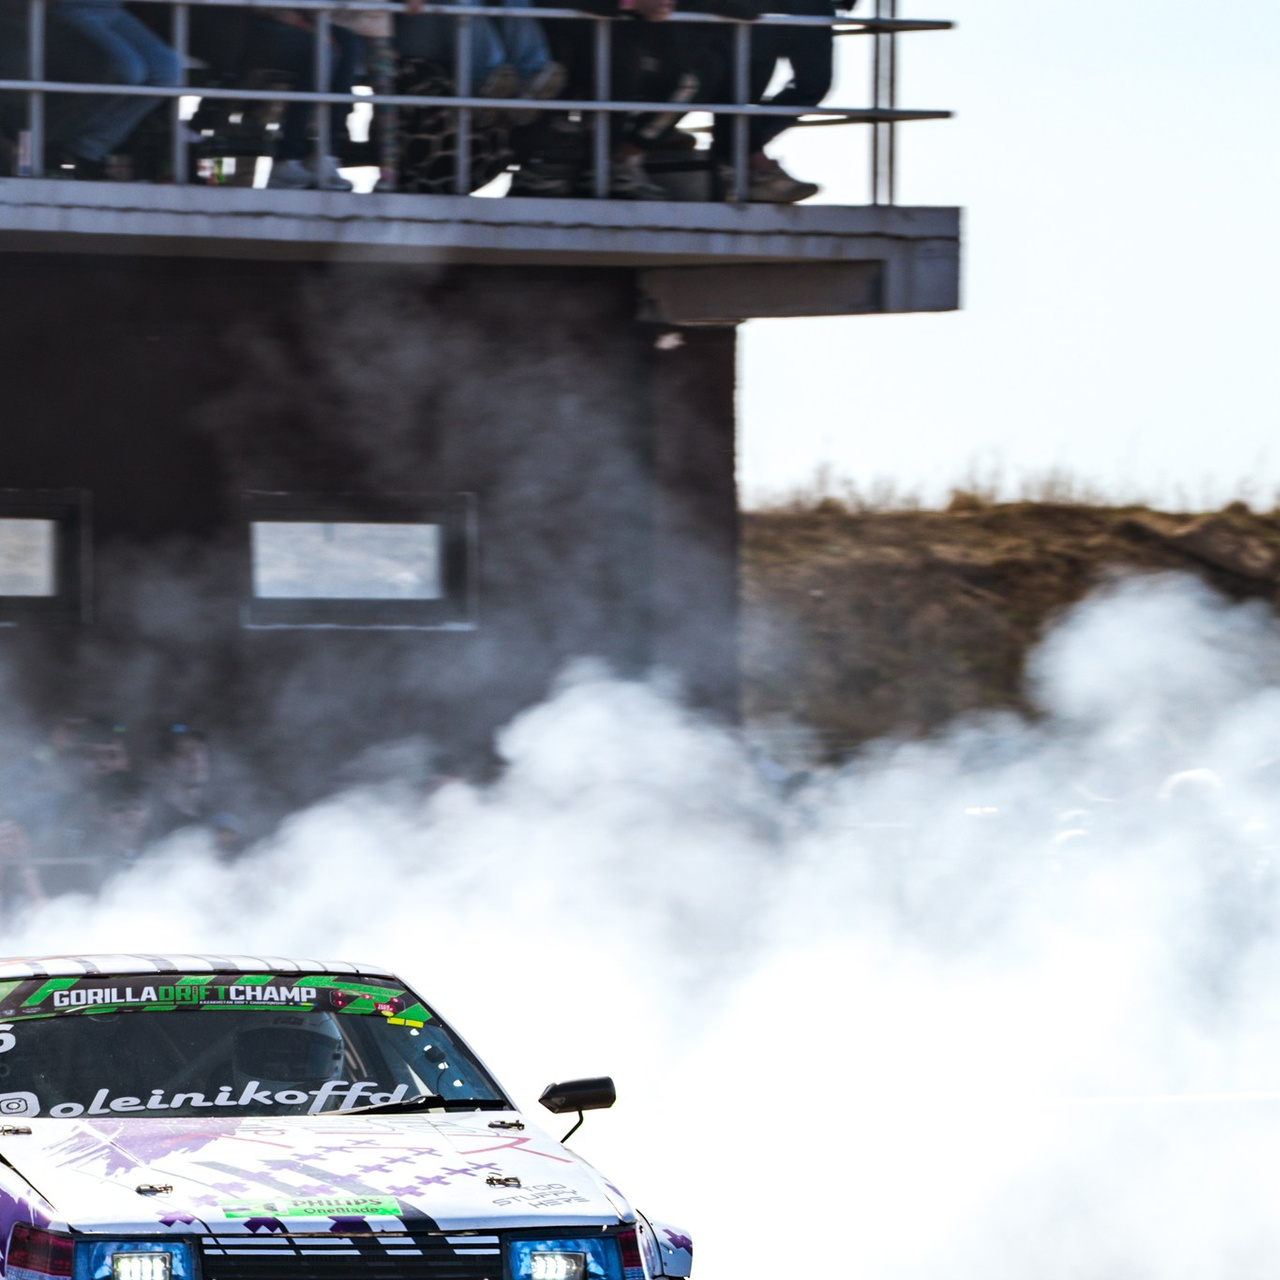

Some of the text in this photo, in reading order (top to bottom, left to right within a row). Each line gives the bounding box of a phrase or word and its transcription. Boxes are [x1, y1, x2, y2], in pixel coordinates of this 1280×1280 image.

[291, 1198, 382, 1207] PHILIPS
[492, 1189, 577, 1206] STUFFY
[528, 1196, 590, 1208] HERE
